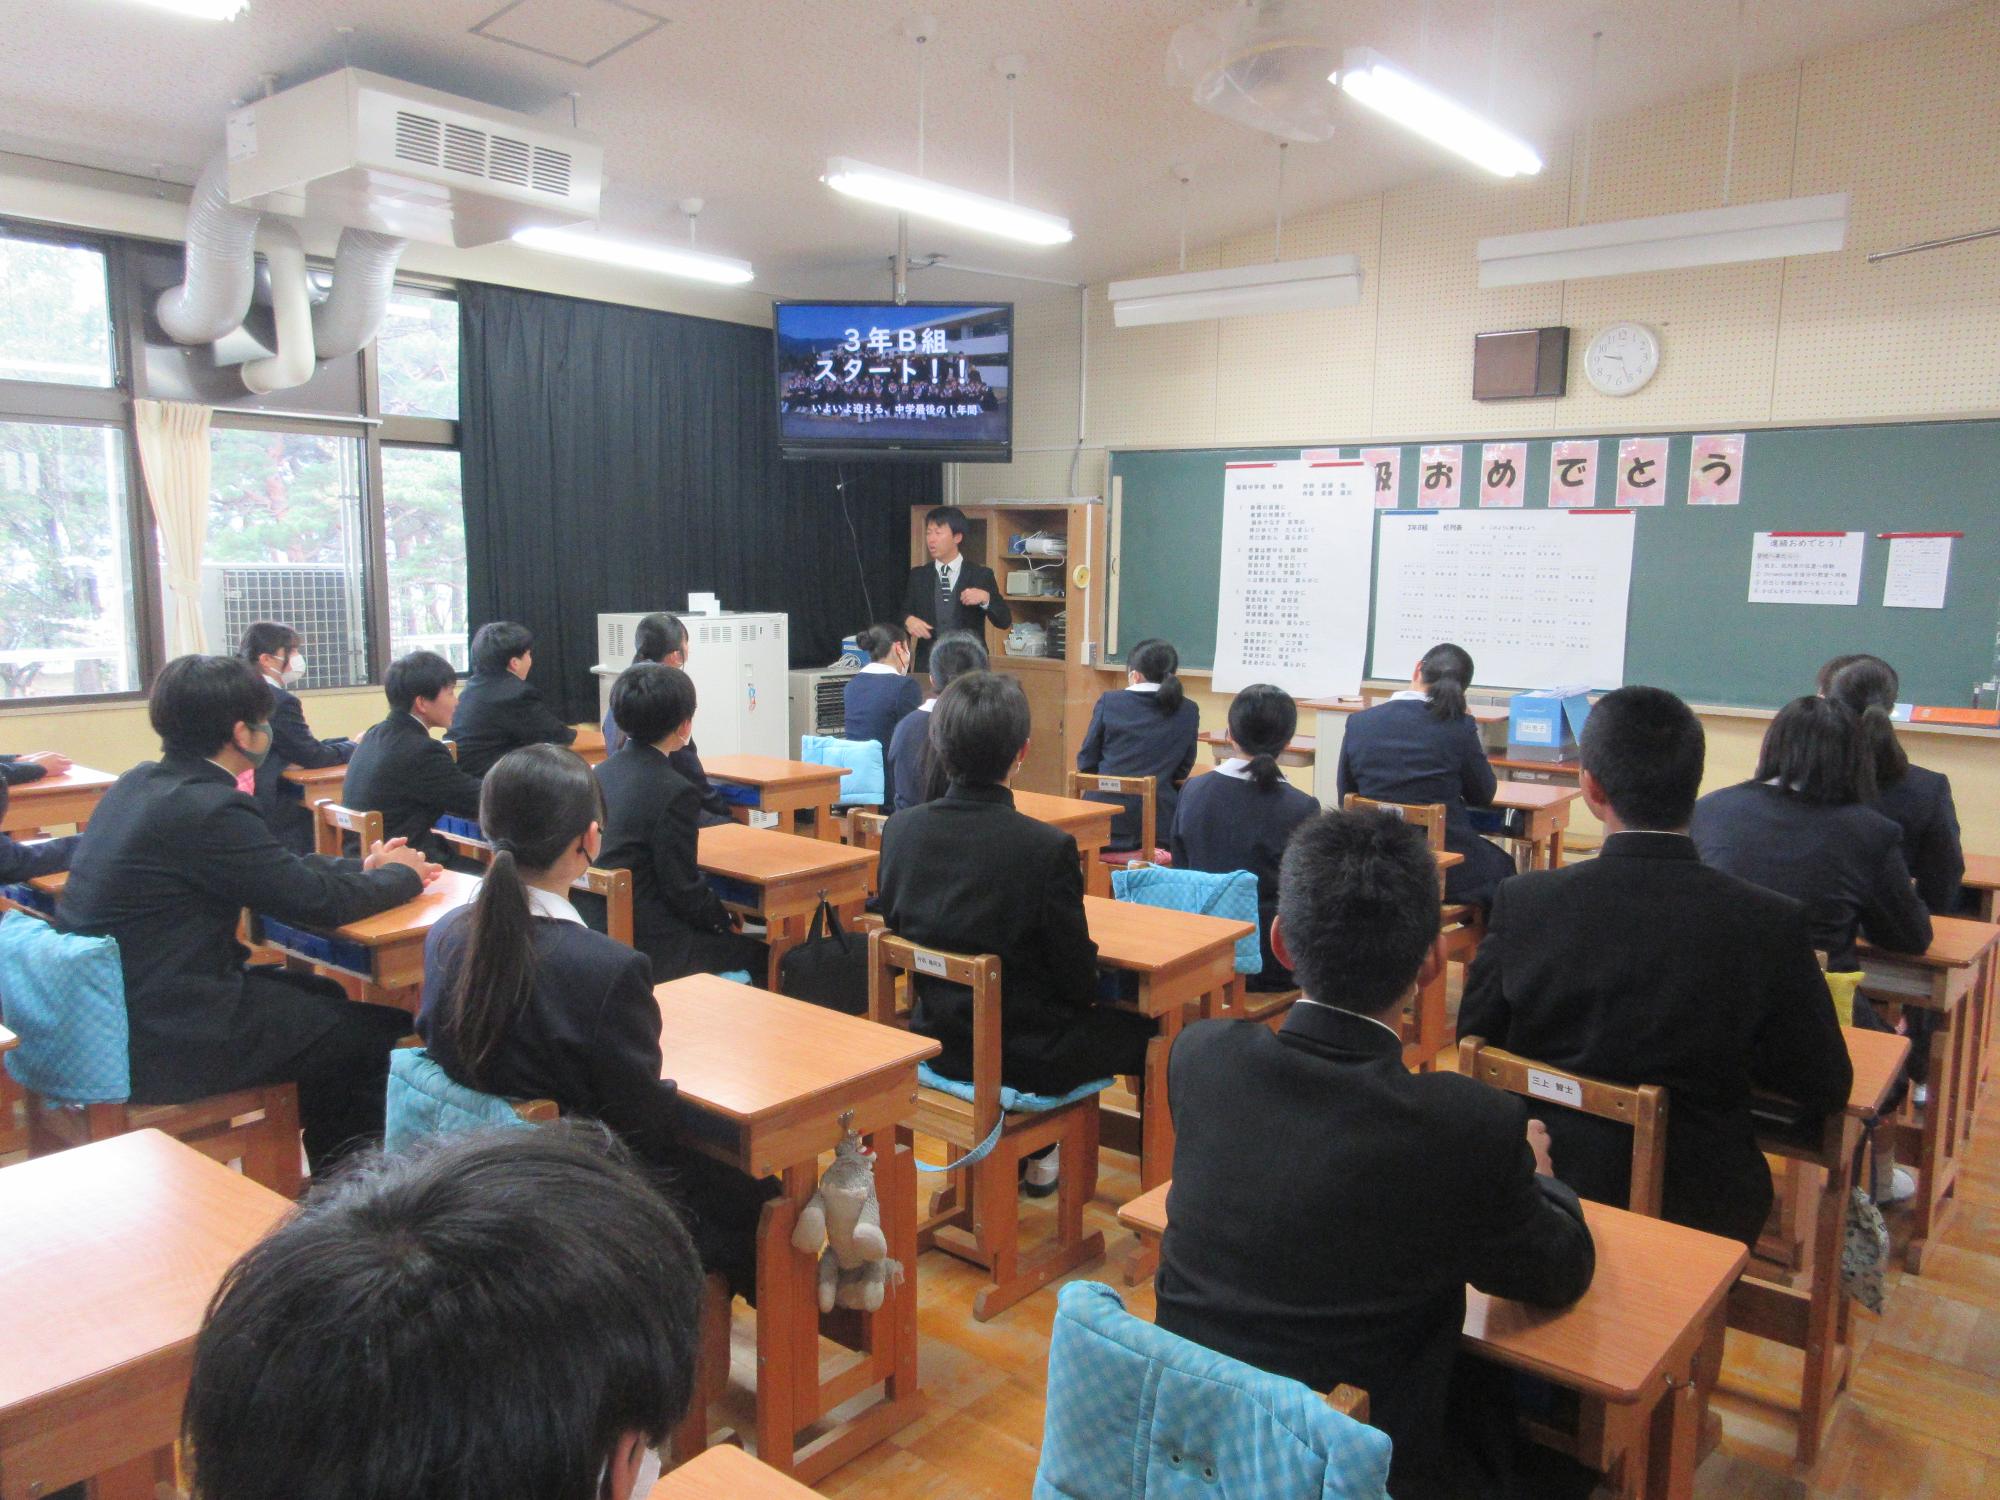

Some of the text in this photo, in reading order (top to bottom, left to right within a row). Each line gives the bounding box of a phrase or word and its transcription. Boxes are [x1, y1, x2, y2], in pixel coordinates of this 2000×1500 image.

[844, 326, 949, 354] 3年B組
[814, 358, 966, 384] スタート!!
[1532, 1076, 1550, 1089] 三上
